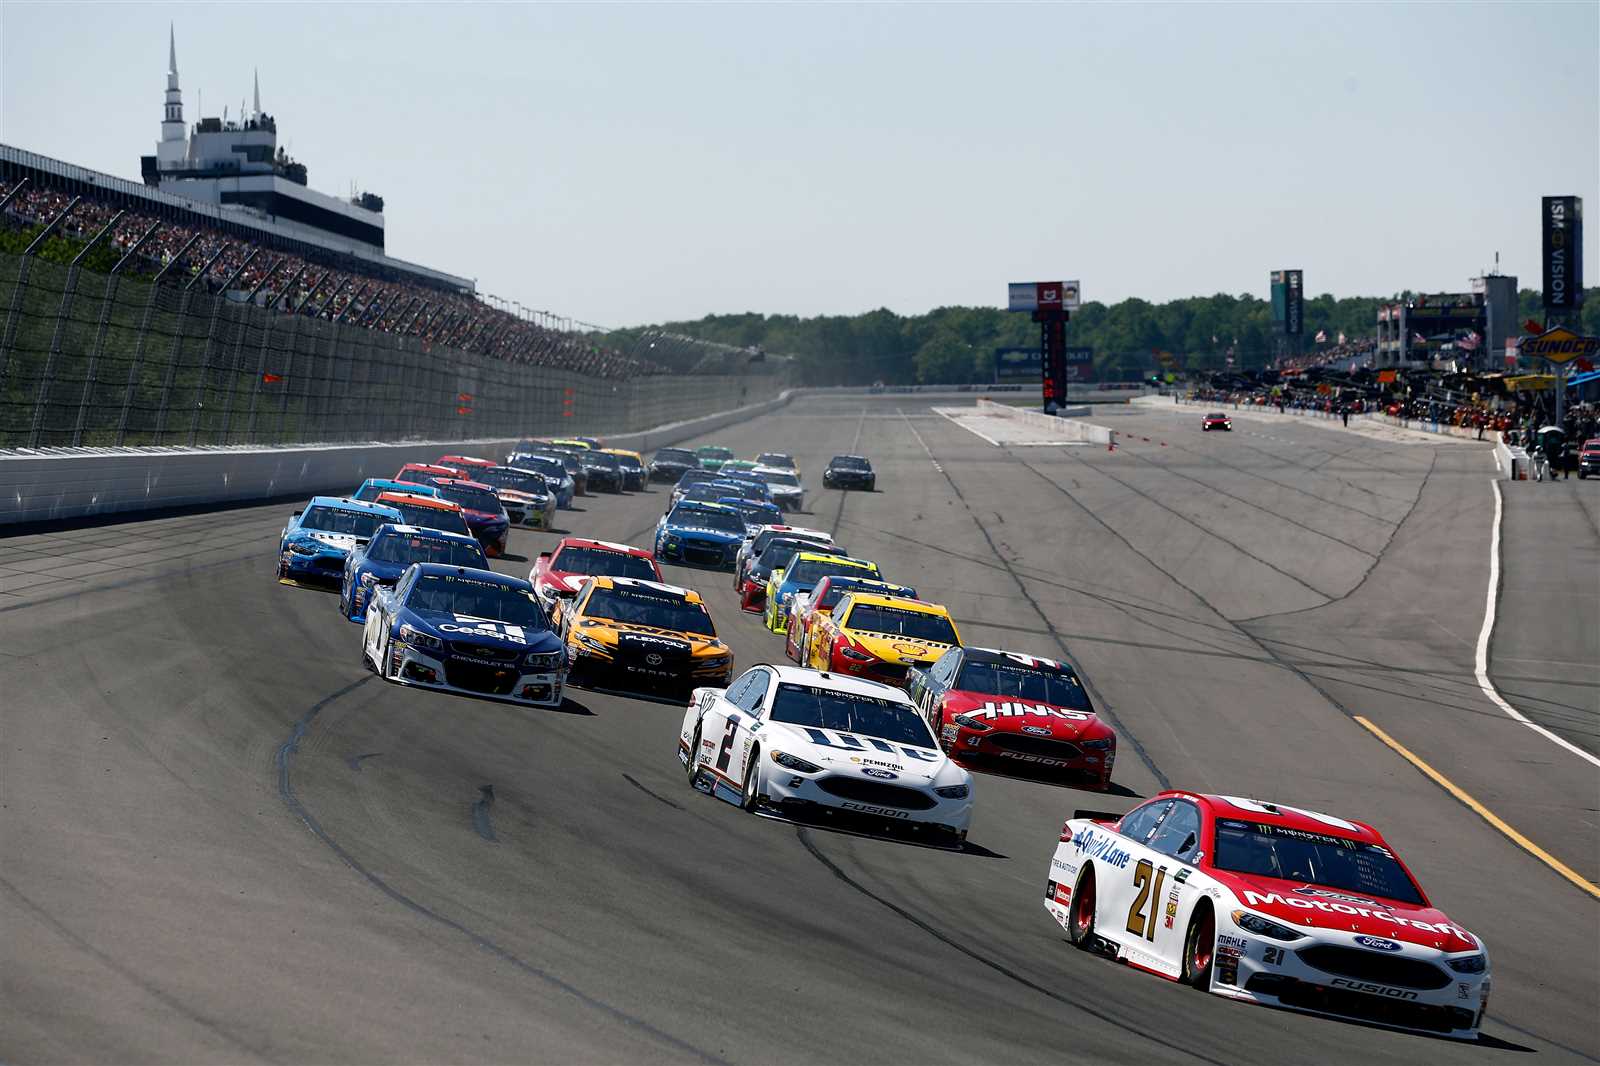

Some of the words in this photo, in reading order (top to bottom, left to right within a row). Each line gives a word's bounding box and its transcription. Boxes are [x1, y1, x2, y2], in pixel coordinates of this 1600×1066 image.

[1551, 199, 1565, 228] ISM
[1551, 249, 1565, 305] VISION
[1525, 339, 1597, 354] SUNOCO
[439, 623, 528, 646] Cessna
[625, 634, 688, 650] FLEXVOLT
[451, 653, 502, 668] CHEVROLET
[825, 690, 874, 703] MONSTER
[715, 713, 742, 774] 2
[967, 736, 982, 747] 41
[863, 757, 905, 771] PENNZOIL
[1000, 752, 1068, 768] FUSION
[868, 768, 892, 779] Ford
[840, 801, 911, 820] FUSION
[1276, 827, 1340, 845] MONSTER
[1100, 840, 1131, 870] Lane
[1125, 857, 1169, 943] 21
[1243, 890, 1471, 943] Motorcraft
[1217, 934, 1248, 949] MAHLE
[1362, 935, 1394, 950] Ford
[1262, 946, 1286, 967] 21
[1330, 977, 1419, 1001] FUSION
